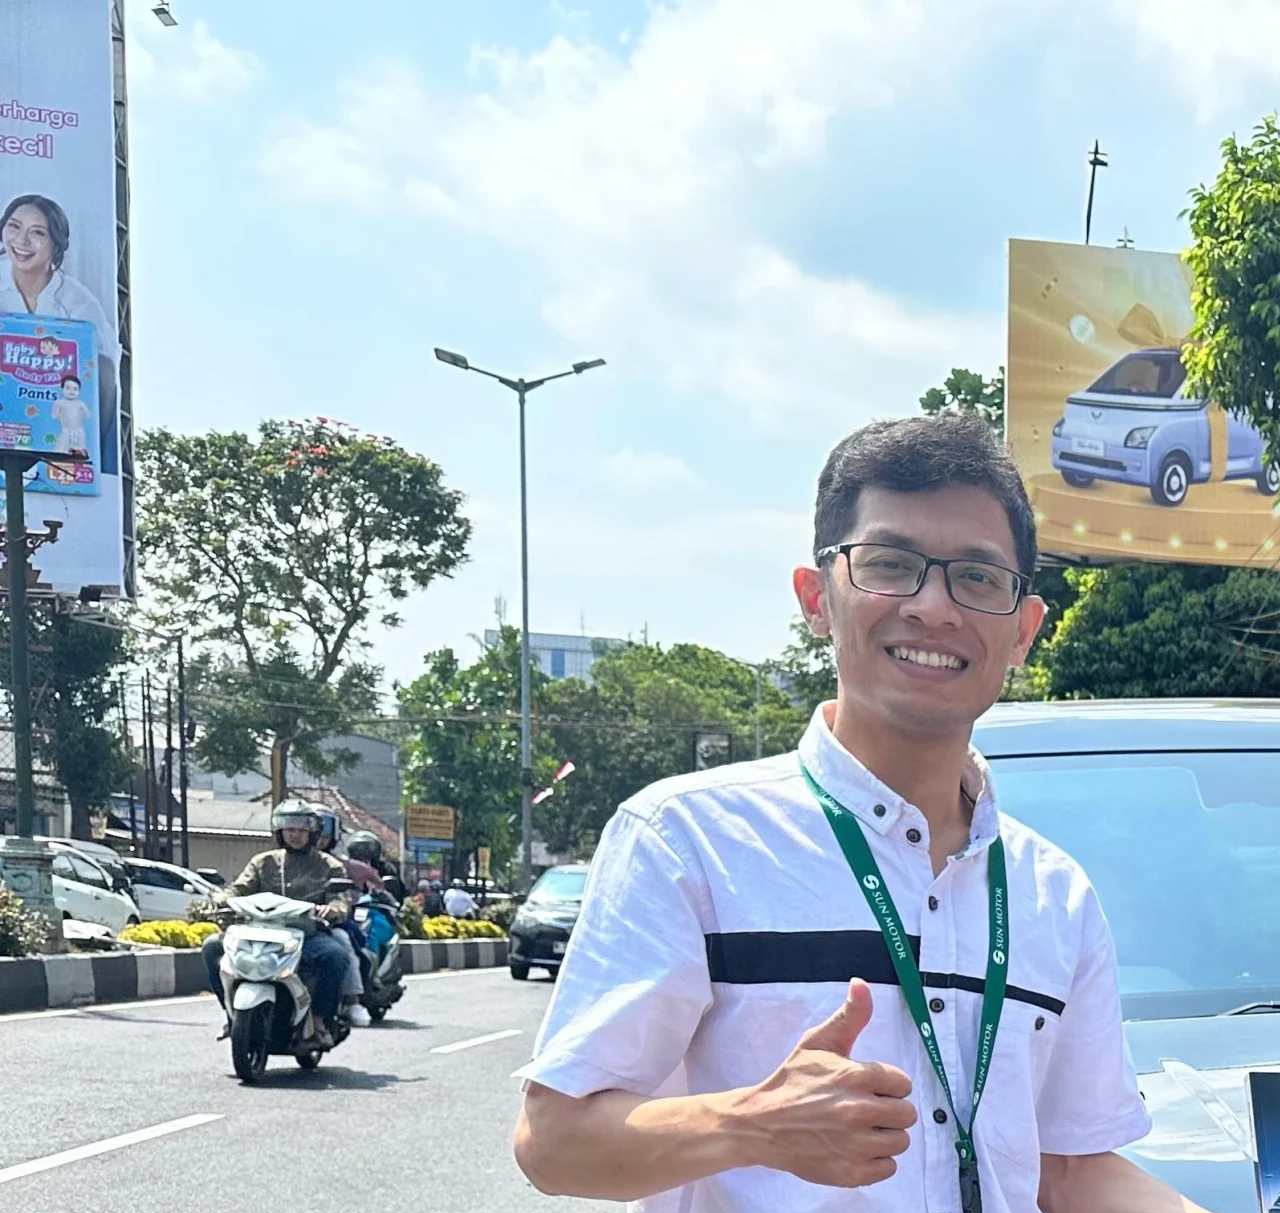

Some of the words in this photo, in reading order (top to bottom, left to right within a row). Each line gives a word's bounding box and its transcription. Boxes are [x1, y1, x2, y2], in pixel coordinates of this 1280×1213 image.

[0, 99, 78, 129] rharga
[4, 342, 36, 356] Baby
[5, 350, 74, 371] Happy!
[18, 386, 58, 401] Pants
[995, 886, 1004, 926] MOTOR
[872, 890, 891, 914] SUN
[883, 915, 908, 961] MOTOR
[995, 926, 1004, 949] SUN
[926, 1038, 940, 1062] SUN
[981, 1023, 994, 1066] MOTOR
[977, 1066, 987, 1090] SUN
